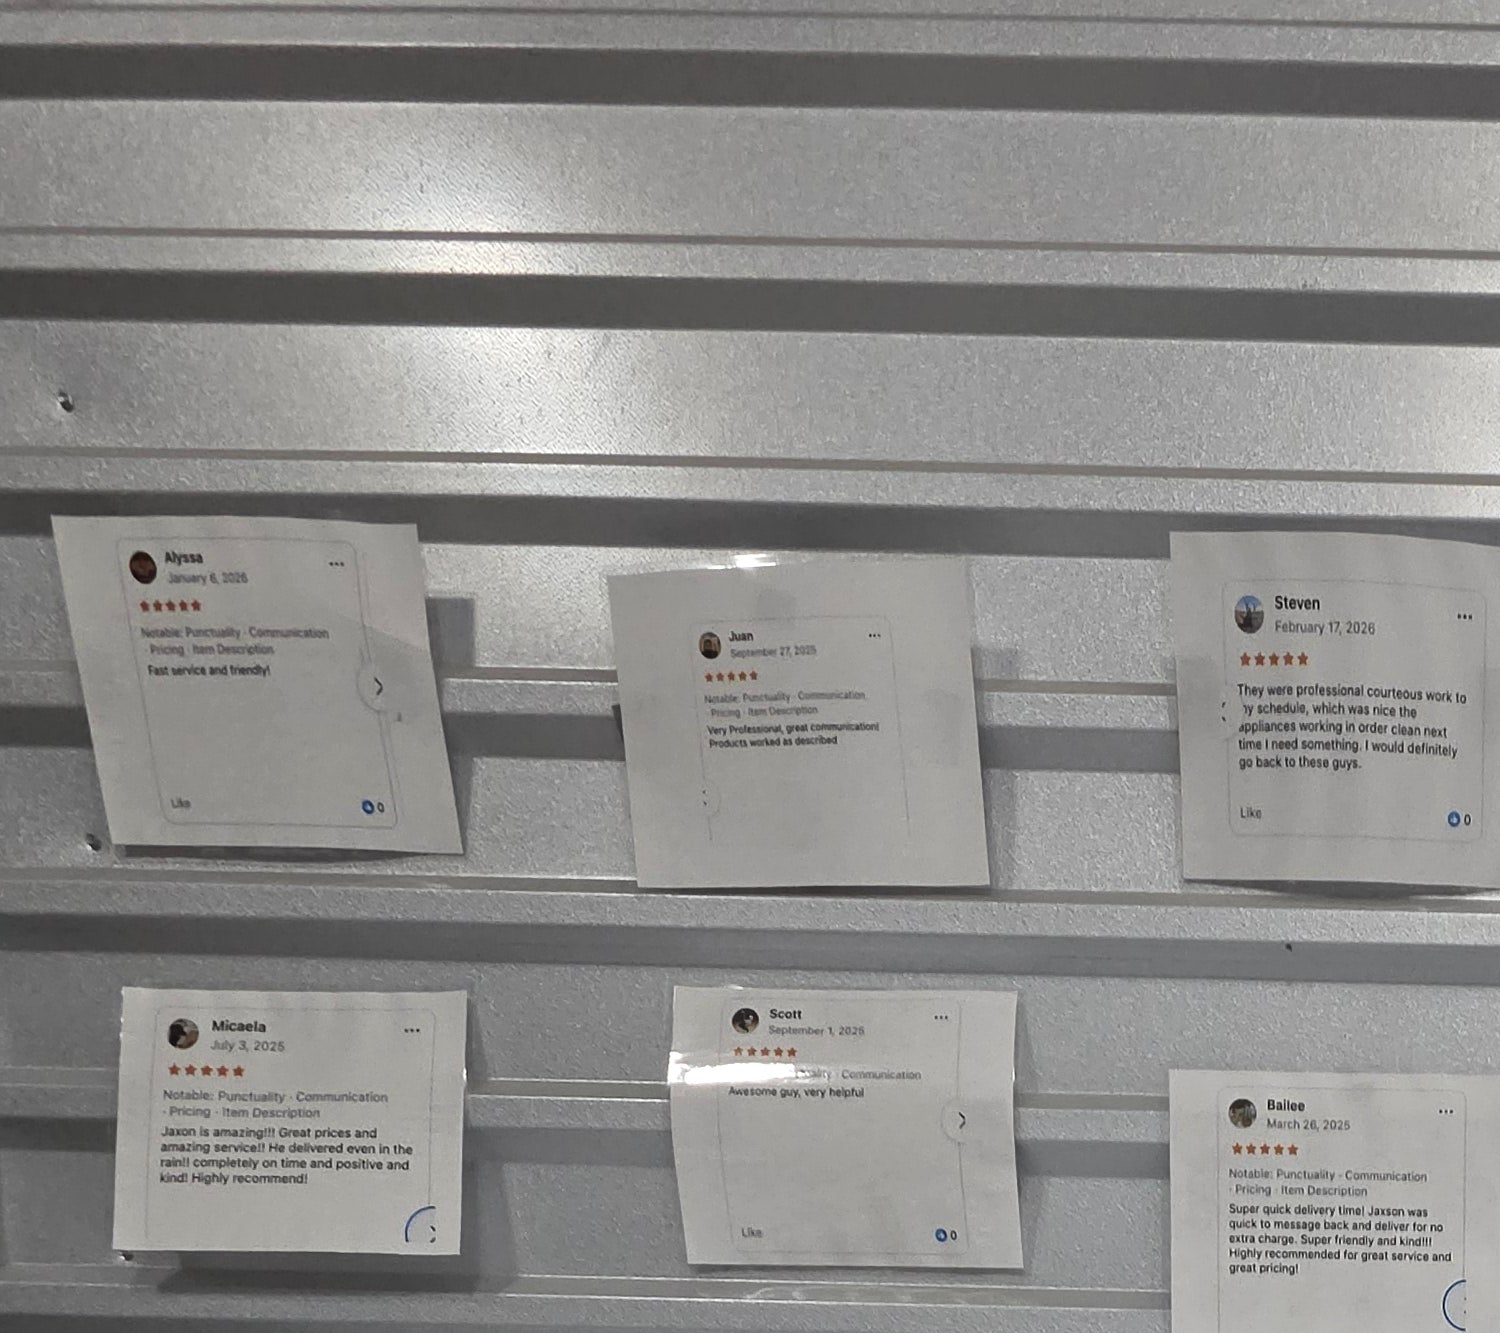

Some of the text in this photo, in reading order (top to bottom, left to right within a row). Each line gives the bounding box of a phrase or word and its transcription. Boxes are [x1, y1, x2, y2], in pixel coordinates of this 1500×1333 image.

[164, 550, 204, 565] Alyssa
[1274, 595, 1320, 611] Steven
[1274, 619, 1325, 636] February
[1328, 620, 1342, 636] 17,
[147, 664, 169, 676] Fast
[170, 663, 207, 676] service
[208, 664, 228, 676] and
[1236, 683, 1467, 704] They were professional courteous work to
[708, 735, 838, 749] Products worked as described
[1238, 754, 1362, 772] go back to these guys.
[1240, 806, 1262, 819] Like
[769, 1008, 802, 1020] Scott
[211, 1019, 266, 1033] Micaela
[768, 1024, 825, 1037] September
[827, 1026, 835, 1037] 1,
[209, 1039, 236, 1053] July
[238, 1039, 249, 1053] 3,
[727, 1086, 777, 1097] Awesome
[803, 1088, 826, 1099] very
[828, 1086, 864, 1099] helpful
[1267, 1098, 1305, 1112] Bailee
[1266, 1117, 1300, 1130] March
[1303, 1118, 1320, 1131] 26,
[191, 1171, 230, 1186] Highly
[1229, 1203, 1260, 1216] Super
[1262, 1203, 1291, 1217] quick
[1293, 1203, 1336, 1218] delivery
[1367, 1205, 1405, 1217] Jaxson
[1406, 1208, 1428, 1218] was
[1228, 1262, 1256, 1275] great
